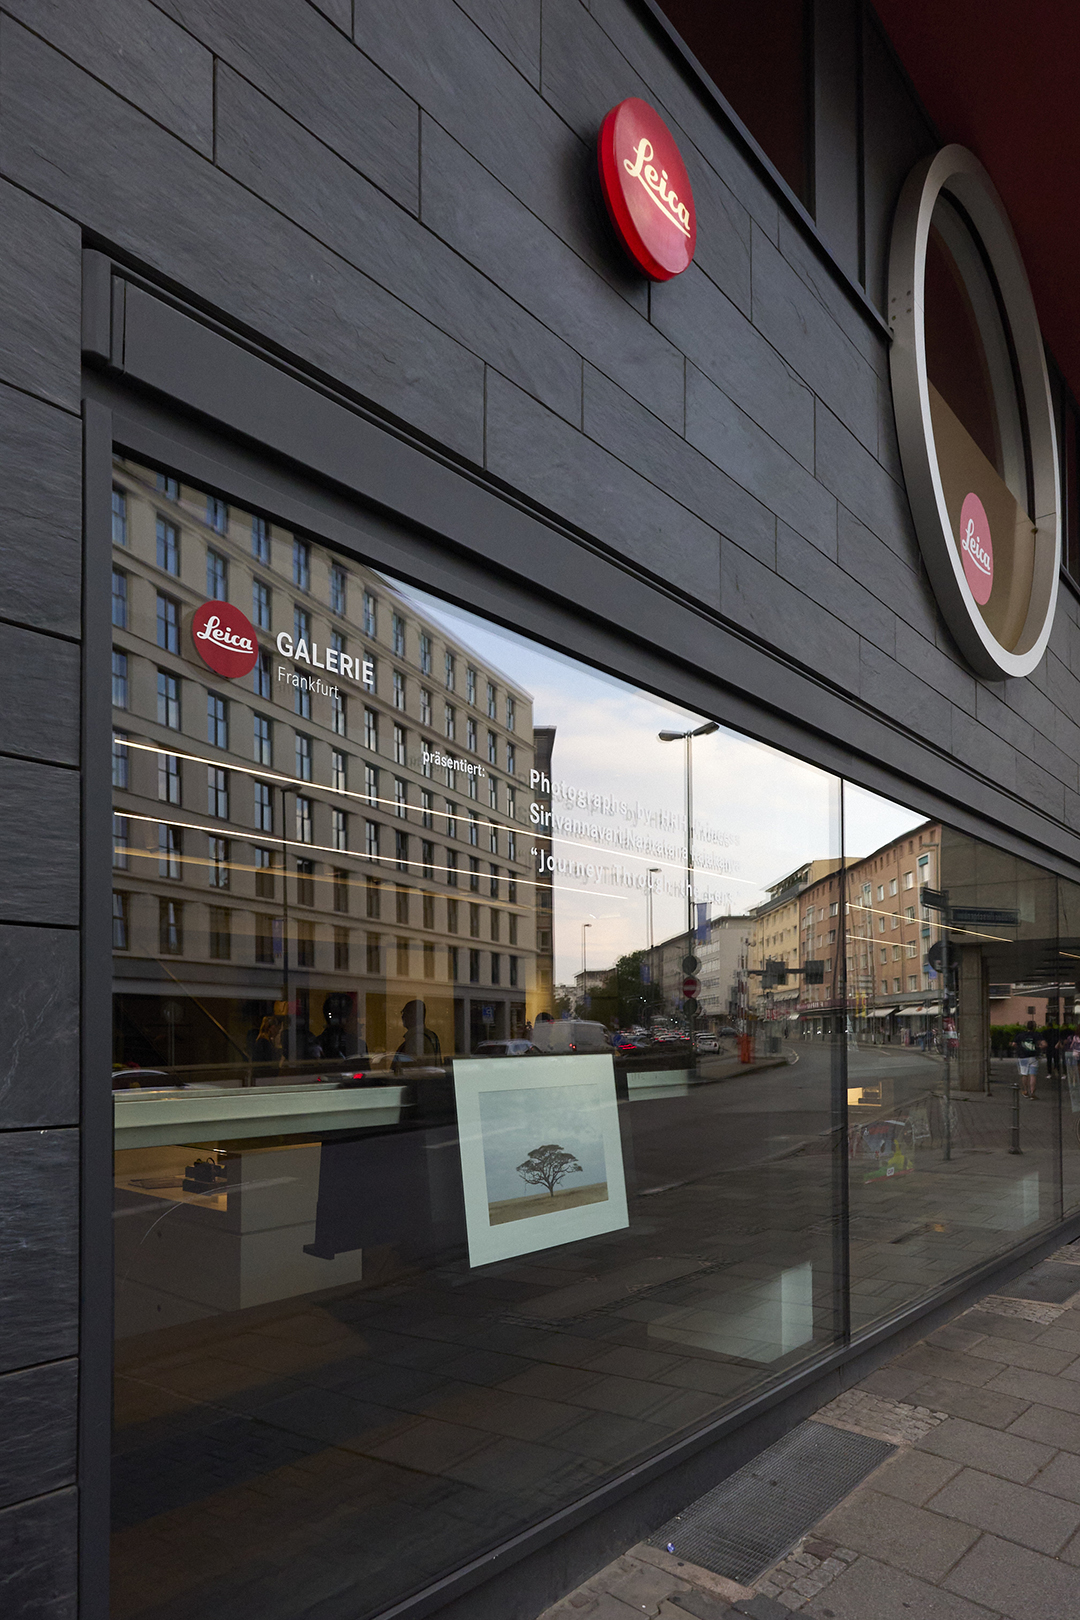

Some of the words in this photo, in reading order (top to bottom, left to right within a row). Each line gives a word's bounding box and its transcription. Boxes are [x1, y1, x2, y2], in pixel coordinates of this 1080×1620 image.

[623, 137, 691, 238] Leica
[962, 518, 991, 575] Leica
[196, 615, 254, 654] Leica
[276, 631, 375, 685] GALERIE
[278, 666, 339, 700] Frankfurt
[423, 750, 486, 778] präsentiert:
[530, 769, 627, 815] Photographs
